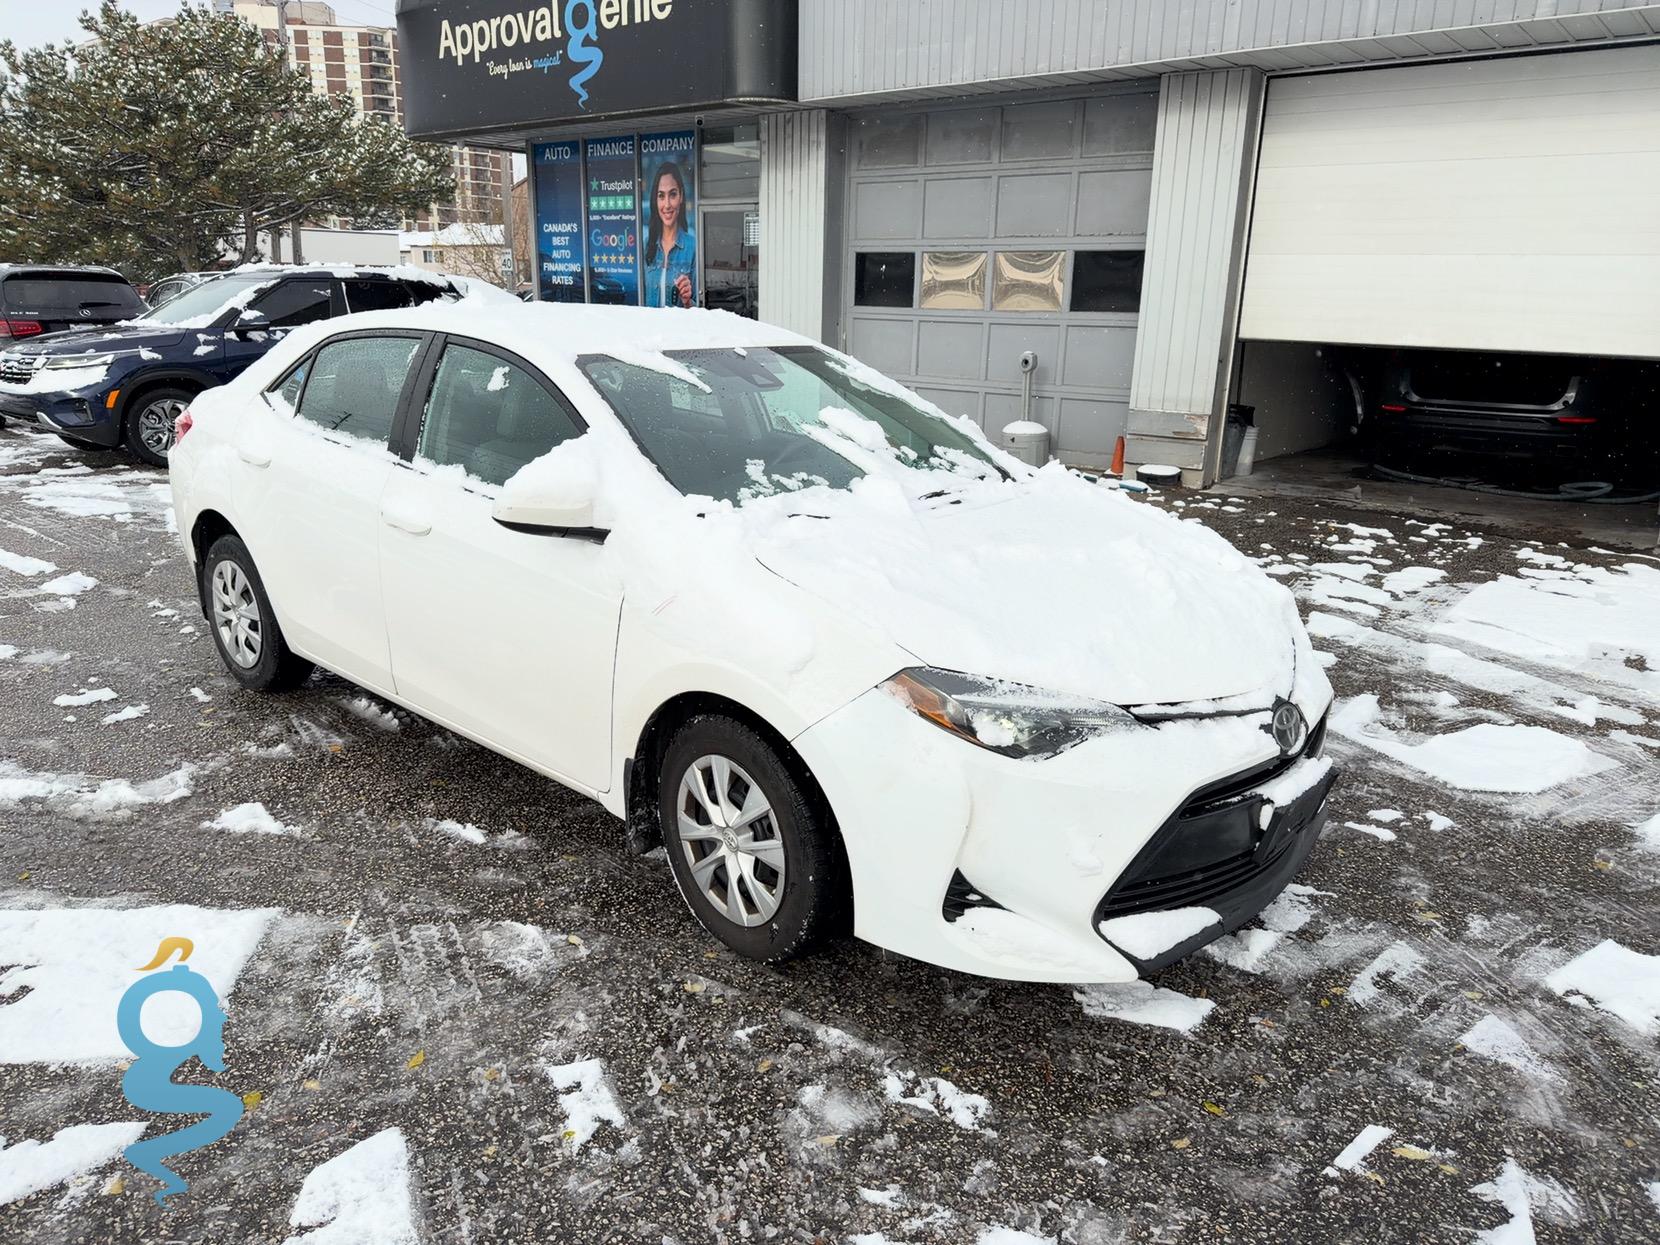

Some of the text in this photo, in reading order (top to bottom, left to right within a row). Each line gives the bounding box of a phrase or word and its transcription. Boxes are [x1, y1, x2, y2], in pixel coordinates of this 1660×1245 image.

[438, 0, 562, 66] Approval
[509, 58, 525, 73] loan
[525, 56, 533, 70] is
[544, 136, 695, 161] AUTO FINANCE COMPANY
[600, 179, 633, 192] Trustpilot
[543, 223, 578, 233] CANADA'S
[552, 236, 570, 246] BEST
[591, 227, 635, 252] Google
[552, 249, 571, 259] AUTO
[502, 258, 512, 269] 40
[543, 262, 581, 273] FINANCING
[551, 275, 574, 286] RATES
